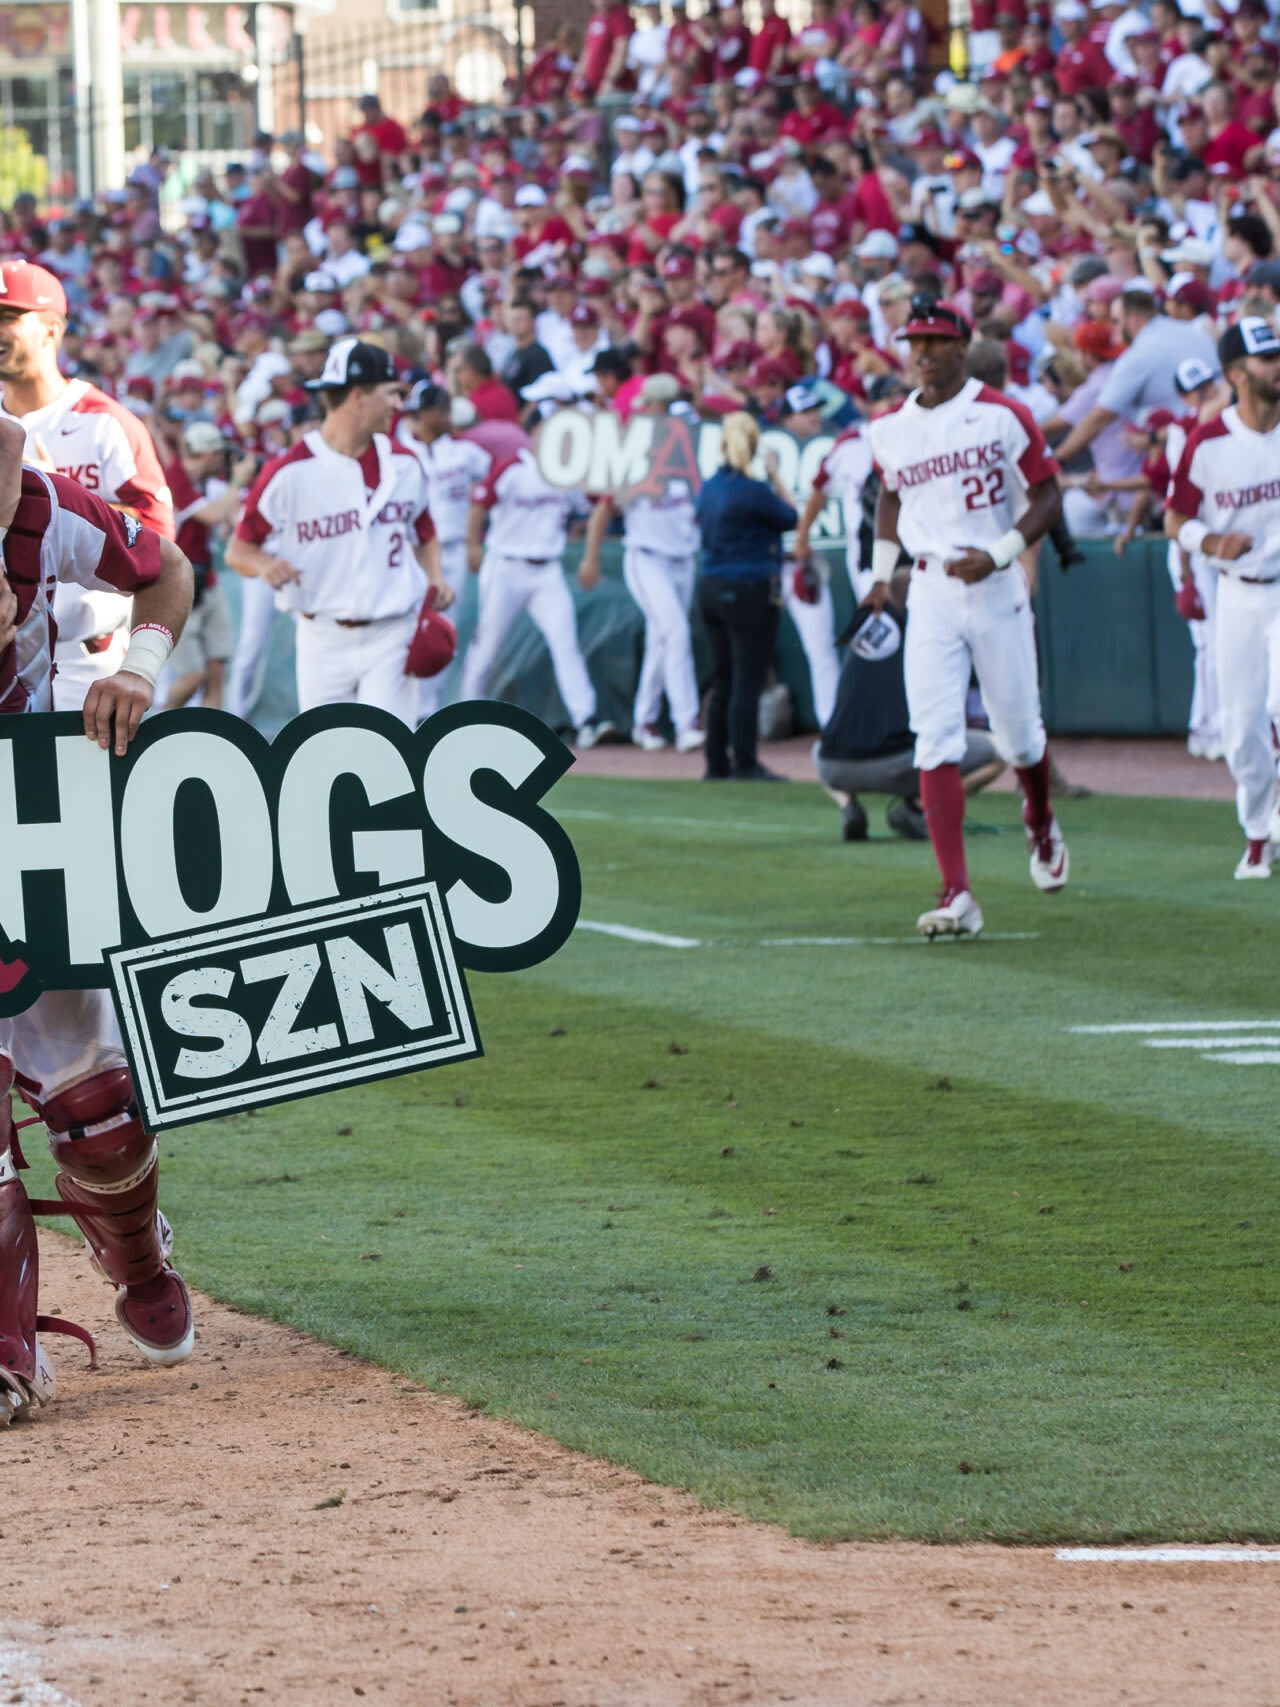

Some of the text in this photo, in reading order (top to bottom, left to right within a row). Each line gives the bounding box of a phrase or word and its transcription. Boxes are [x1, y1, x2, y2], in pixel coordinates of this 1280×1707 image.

[896, 439, 1005, 492] AZORBACKS
[962, 467, 1005, 512] 22
[388, 531, 403, 568] 2
[161, 922, 433, 1079] SZN
[40, 1366, 53, 1386] A
